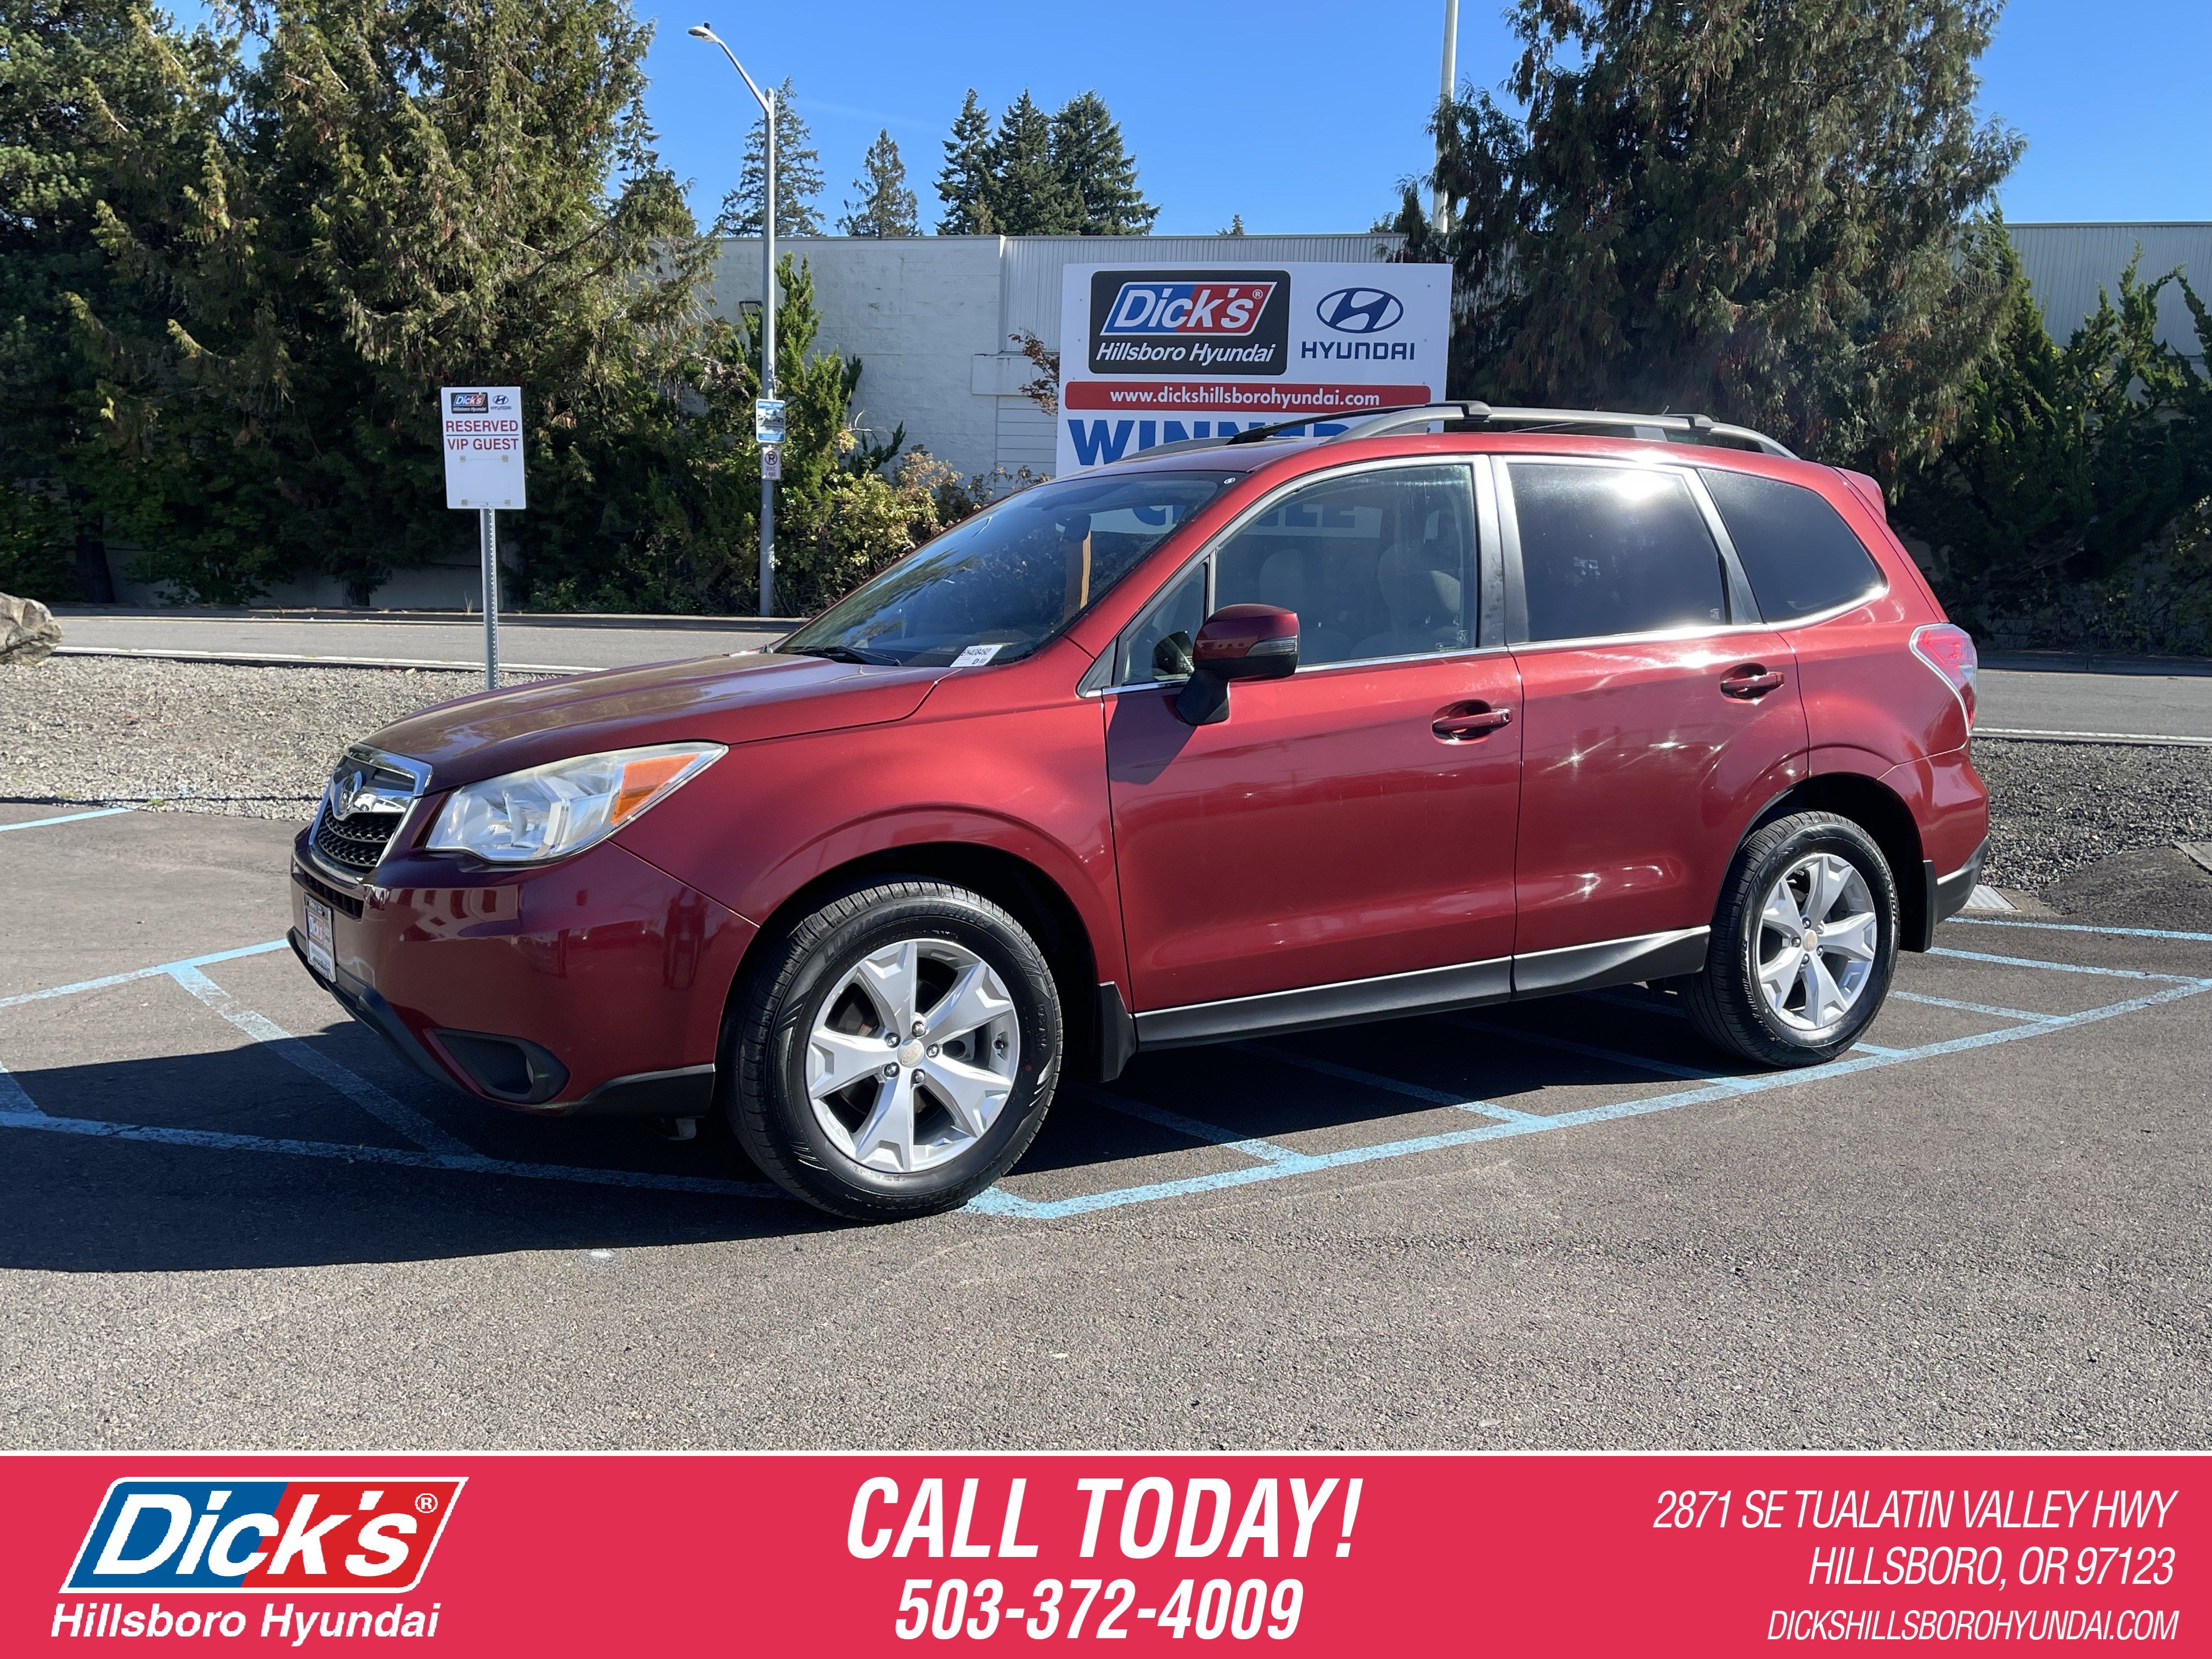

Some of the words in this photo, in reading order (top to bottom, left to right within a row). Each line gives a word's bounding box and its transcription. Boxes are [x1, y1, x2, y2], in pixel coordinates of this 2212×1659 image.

[1096, 342, 1186, 361] Hillsboro
[1189, 343, 1276, 366] Hyundai
[1301, 341, 1415, 360] HYUNDAI
[1109, 386, 1380, 408] www.dickshillsborohyundai.com
[446, 420, 518, 432] RESERVED
[447, 438, 469, 450] VIP
[473, 438, 518, 450] GUEST
